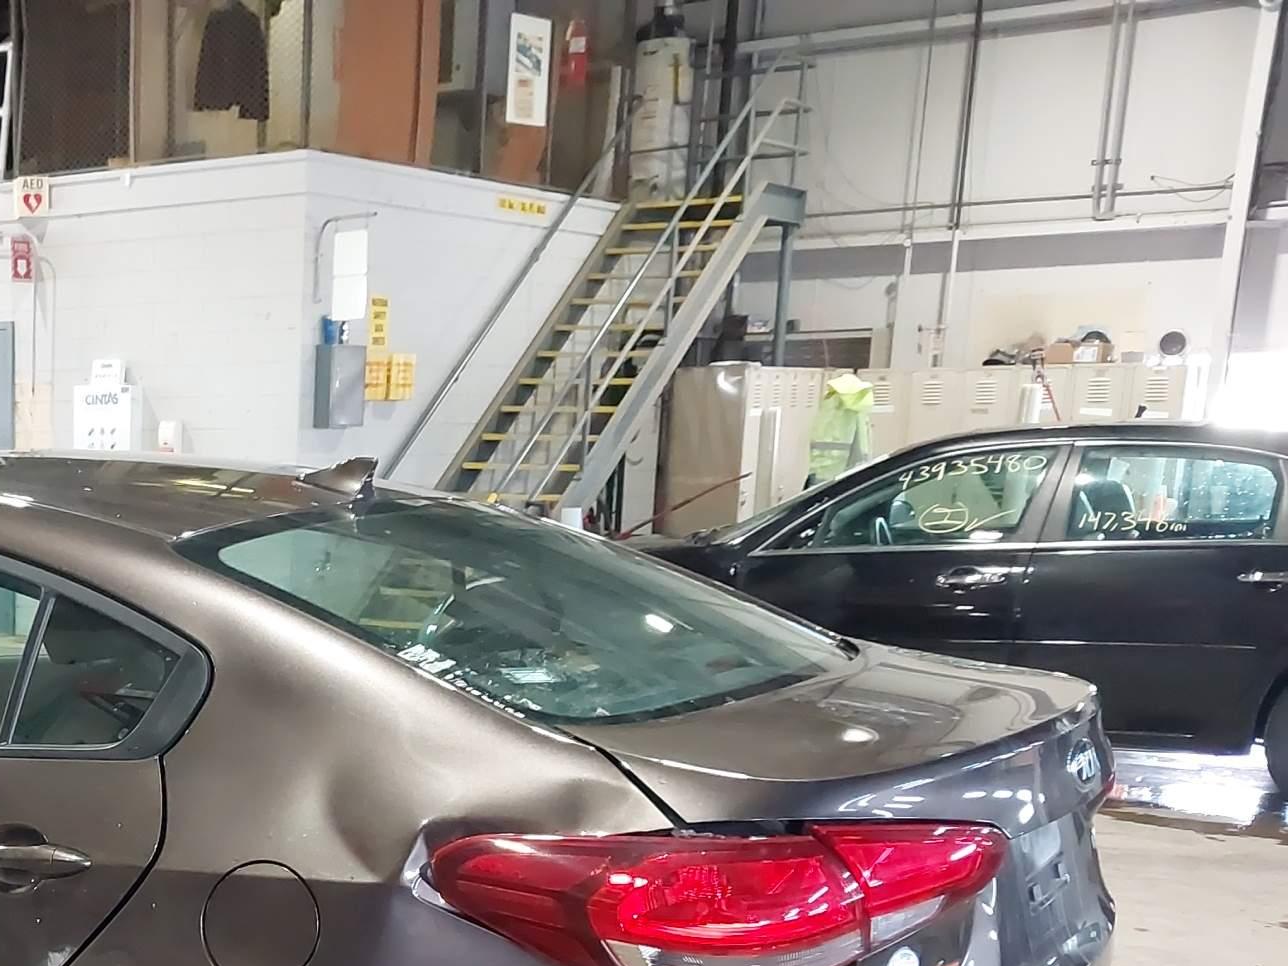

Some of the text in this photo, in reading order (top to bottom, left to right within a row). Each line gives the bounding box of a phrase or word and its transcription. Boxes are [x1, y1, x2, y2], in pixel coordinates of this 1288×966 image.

[22, 178, 44, 190] AED
[85, 392, 119, 405] CINTAS
[899, 454, 1047, 491] 43935480
